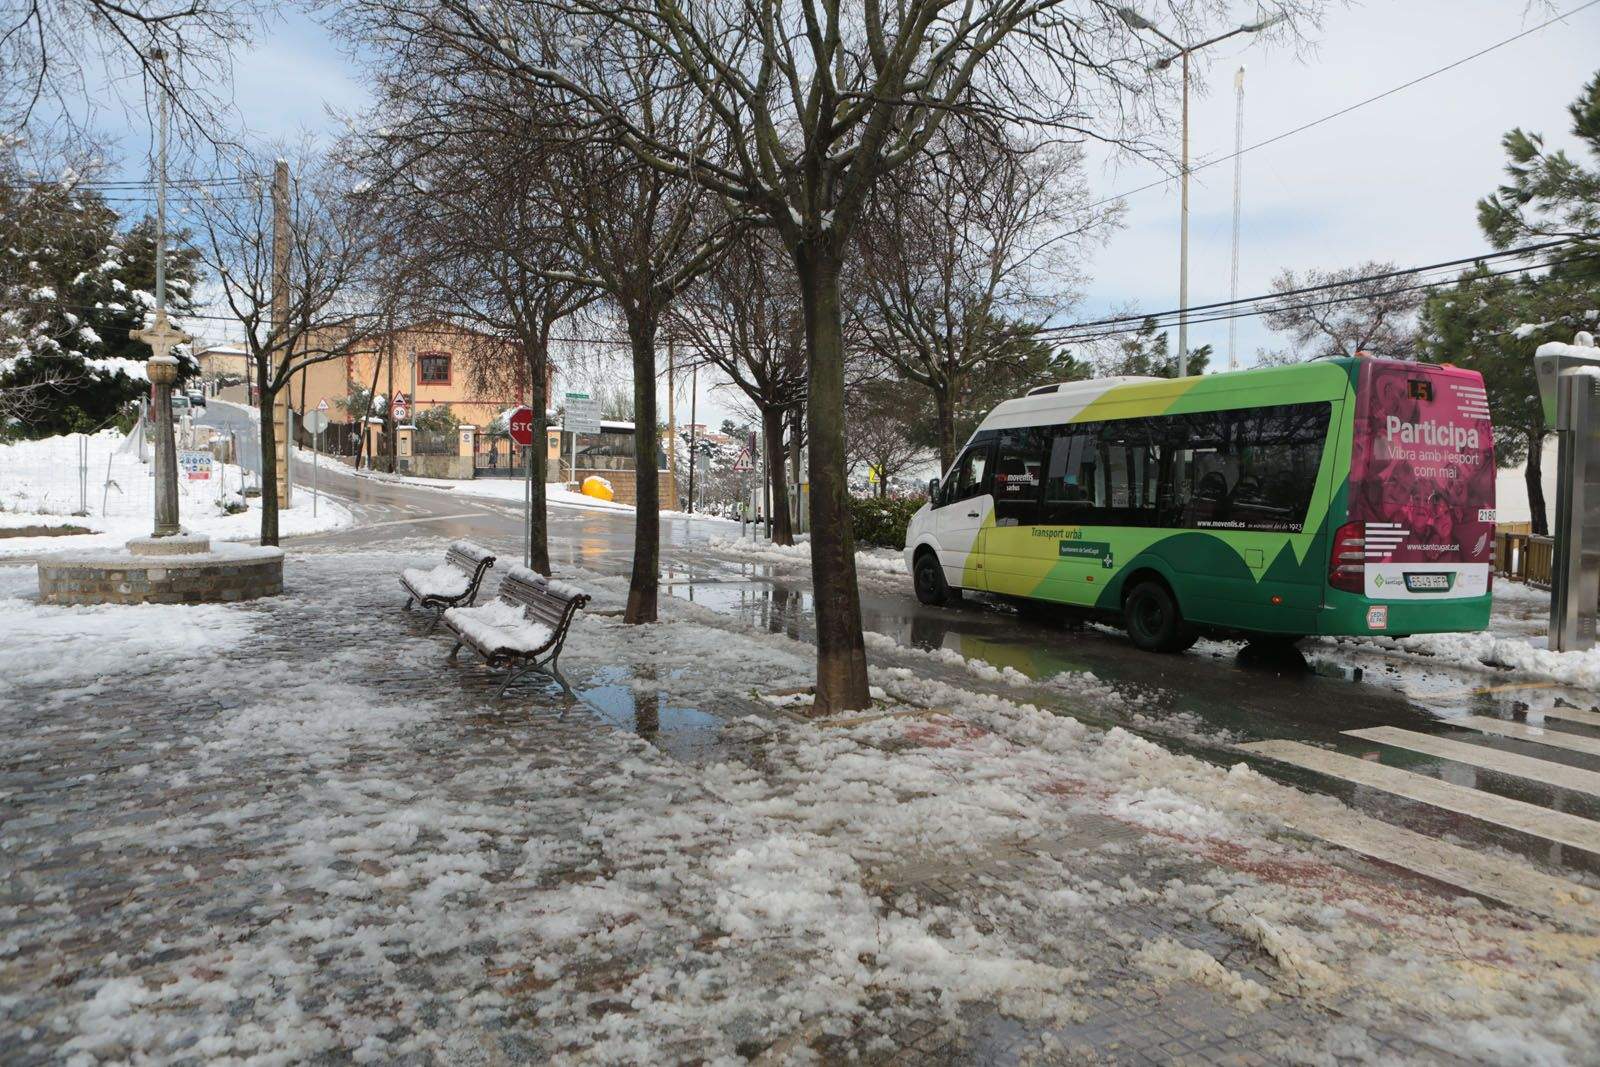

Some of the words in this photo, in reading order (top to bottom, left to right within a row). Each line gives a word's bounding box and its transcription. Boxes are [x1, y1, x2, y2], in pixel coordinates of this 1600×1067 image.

[512, 422, 533, 432] STO
[1386, 415, 1479, 453] Participa
[1388, 446, 1416, 460] Vibra
[1419, 449, 1441, 462] amb
[1443, 451, 1480, 465] l'esport
[1414, 466, 1437, 476] com
[1439, 466, 1457, 478] mai
[1479, 510, 1496, 521] 2180
[1197, 520, 1246, 528] www.moventis.es
[1289, 523, 1302, 531] 1923
[1031, 527, 1064, 540] Transport
[1407, 543, 1460, 552] www.santcugat.cat
